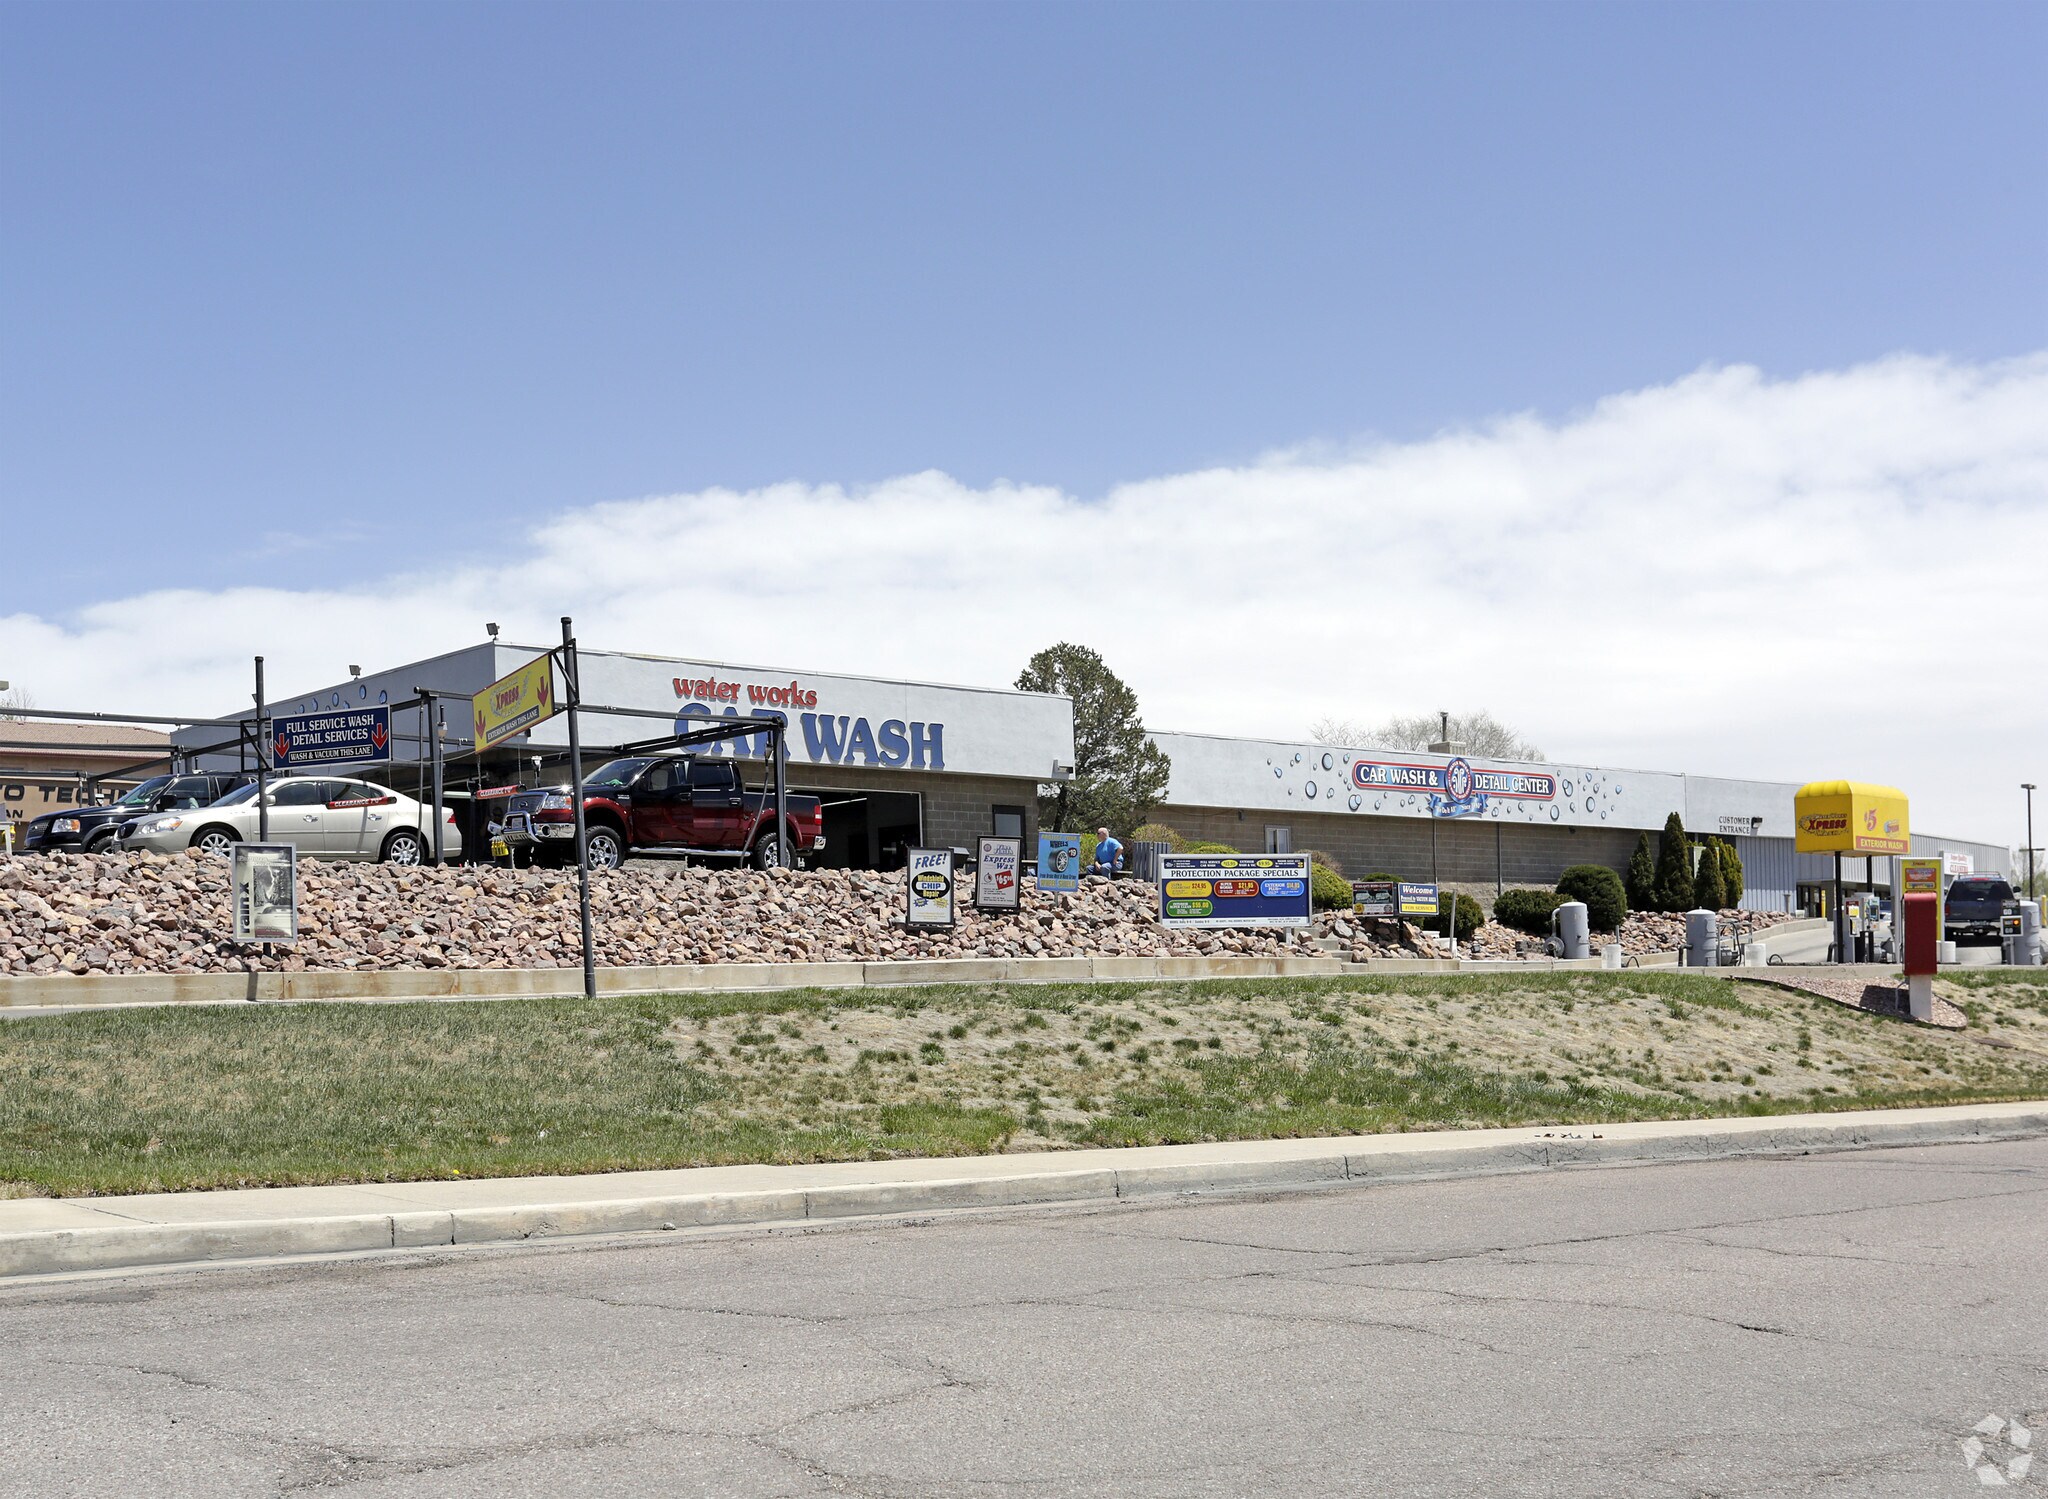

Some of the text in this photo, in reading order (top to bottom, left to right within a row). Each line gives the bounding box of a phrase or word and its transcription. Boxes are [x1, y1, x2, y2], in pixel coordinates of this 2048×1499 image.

[496, 685, 519, 711] XPRESS
[673, 677, 818, 709] water works
[286, 714, 375, 734] FULL SERVICE WASH
[487, 708, 538, 740] EXTERIOR WASH THIS LANE
[292, 728, 368, 746] DETAIL SERVICES
[800, 713, 945, 770] WASH
[290, 746, 371, 761] WASH & VACUUM THIS LANE
[1360, 766, 1387, 784] CAR
[1390, 769, 1426, 786] WASH
[1428, 770, 1439, 786] &
[1475, 774, 1509, 791] DETAIL
[1512, 777, 1550, 794] CENTER
[334, 798, 370, 807] CLEARANCE
[1719, 815, 1750, 825] CUSTOMER
[1808, 819, 1847, 831] XPRESS
[1863, 809, 1878, 832] $5
[1719, 825, 1750, 835] ENTRANCE
[1860, 838, 1905, 850] EXTERIOR WASH
[915, 853, 948, 870] FREE!
[983, 854, 1016, 864] Express
[996, 862, 1015, 870] Wax
[917, 874, 945, 883] Windshield
[1171, 869, 1299, 878] PROTECTION PACKAGE SPECIALS
[921, 882, 941, 890] CHIP
[1402, 885, 1434, 895] Welcome
[923, 890, 940, 898] Repair
